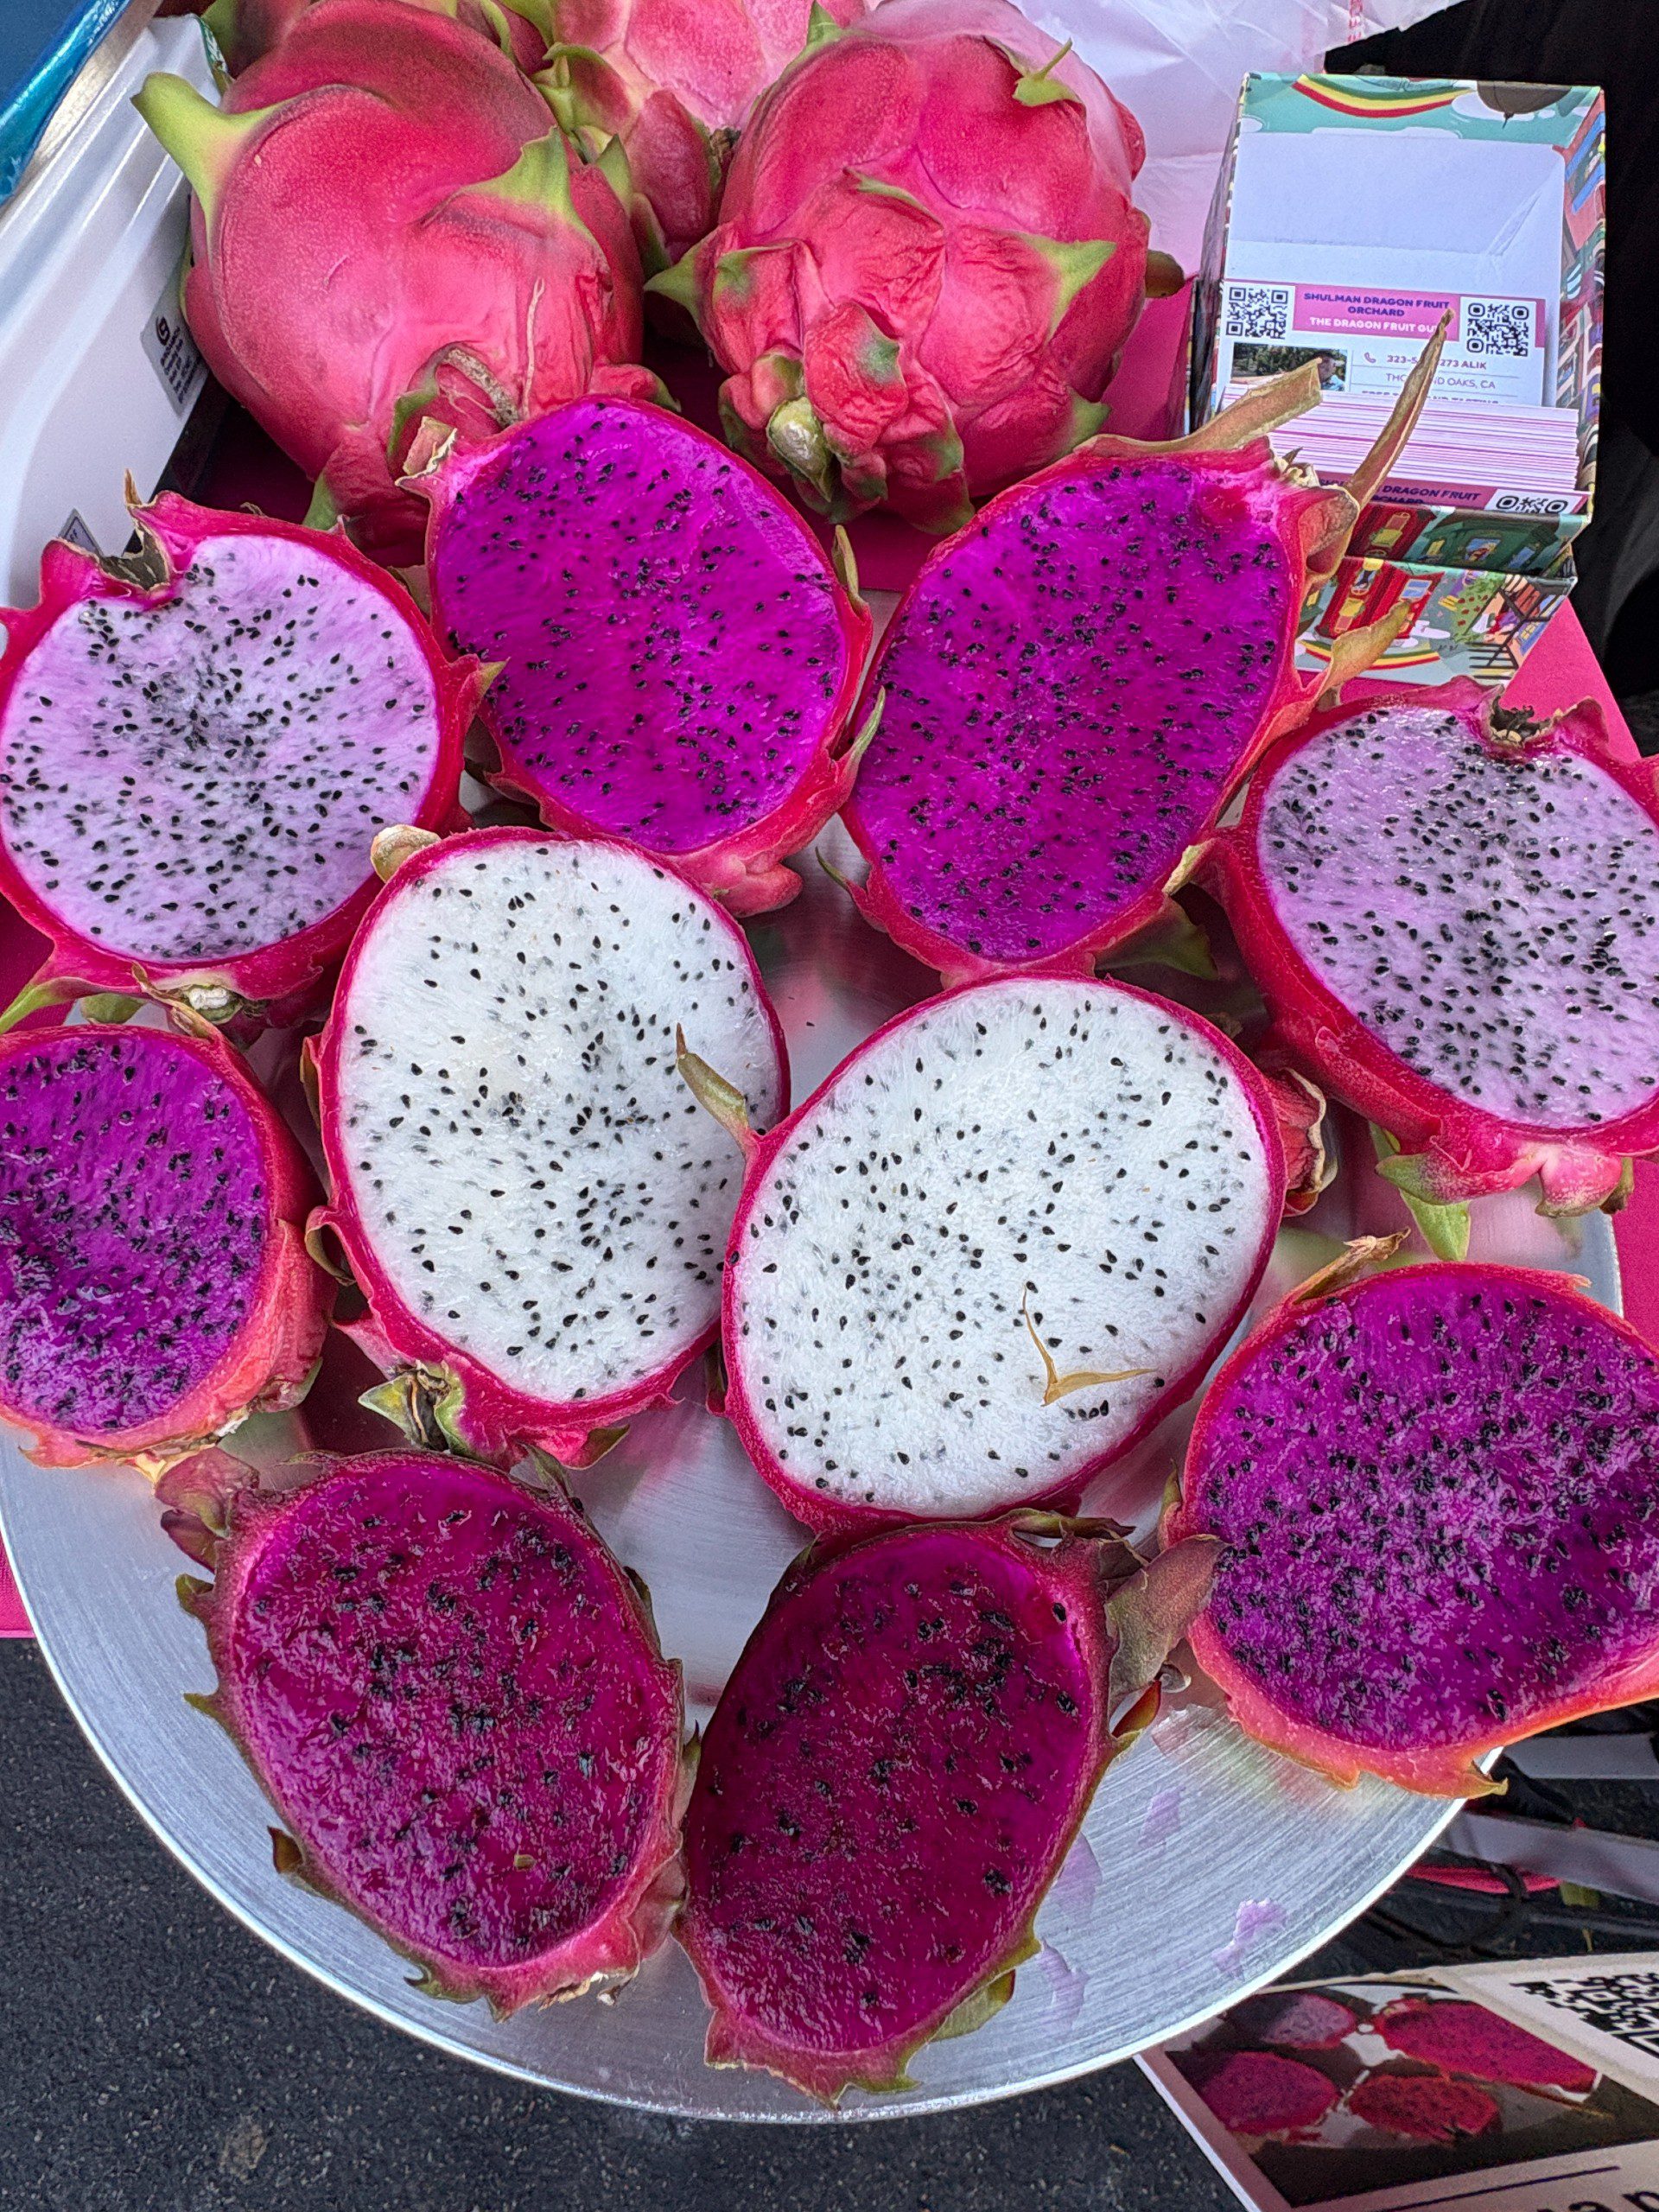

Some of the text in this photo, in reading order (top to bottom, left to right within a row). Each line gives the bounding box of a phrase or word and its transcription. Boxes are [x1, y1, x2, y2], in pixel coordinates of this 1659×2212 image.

[1304, 293, 1450, 309] SHULMAN DRAGON FRUIT
[1348, 306, 1405, 316] ORCHARD
[1310, 317, 1332, 327] THE
[1333, 319, 1382, 329] DRAGON
[1383, 322, 1416, 333] FRUIT
[1460, 360, 1487, 370] ALIK
[1447, 378, 1478, 389] OAKS,
[1480, 380, 1496, 389] CA
[1382, 485, 1481, 501] DRAGON FRUIT
